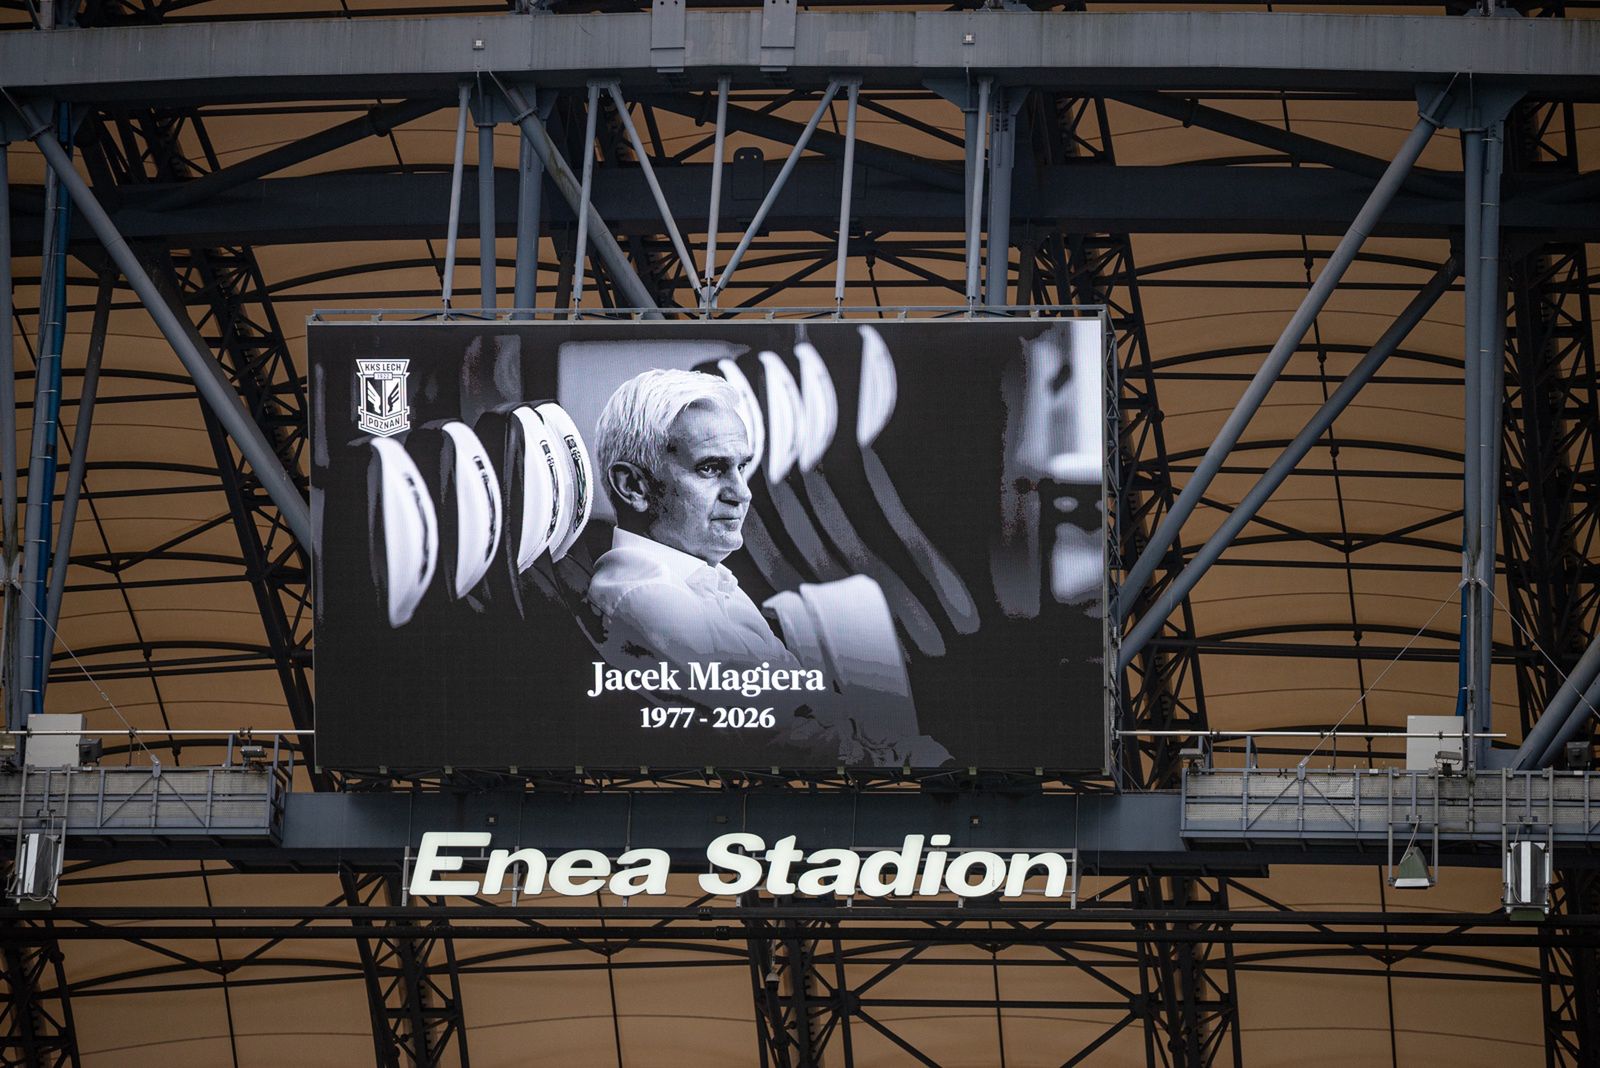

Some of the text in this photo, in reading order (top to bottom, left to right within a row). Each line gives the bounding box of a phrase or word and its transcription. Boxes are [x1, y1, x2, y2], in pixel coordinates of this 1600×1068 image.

[365, 363, 401, 371] KKS LECH
[587, 661, 826, 697] Jacek Magiera
[640, 707, 695, 728] 1977
[712, 707, 776, 728] 2026
[409, 831, 1068, 897] Enea Stadion
